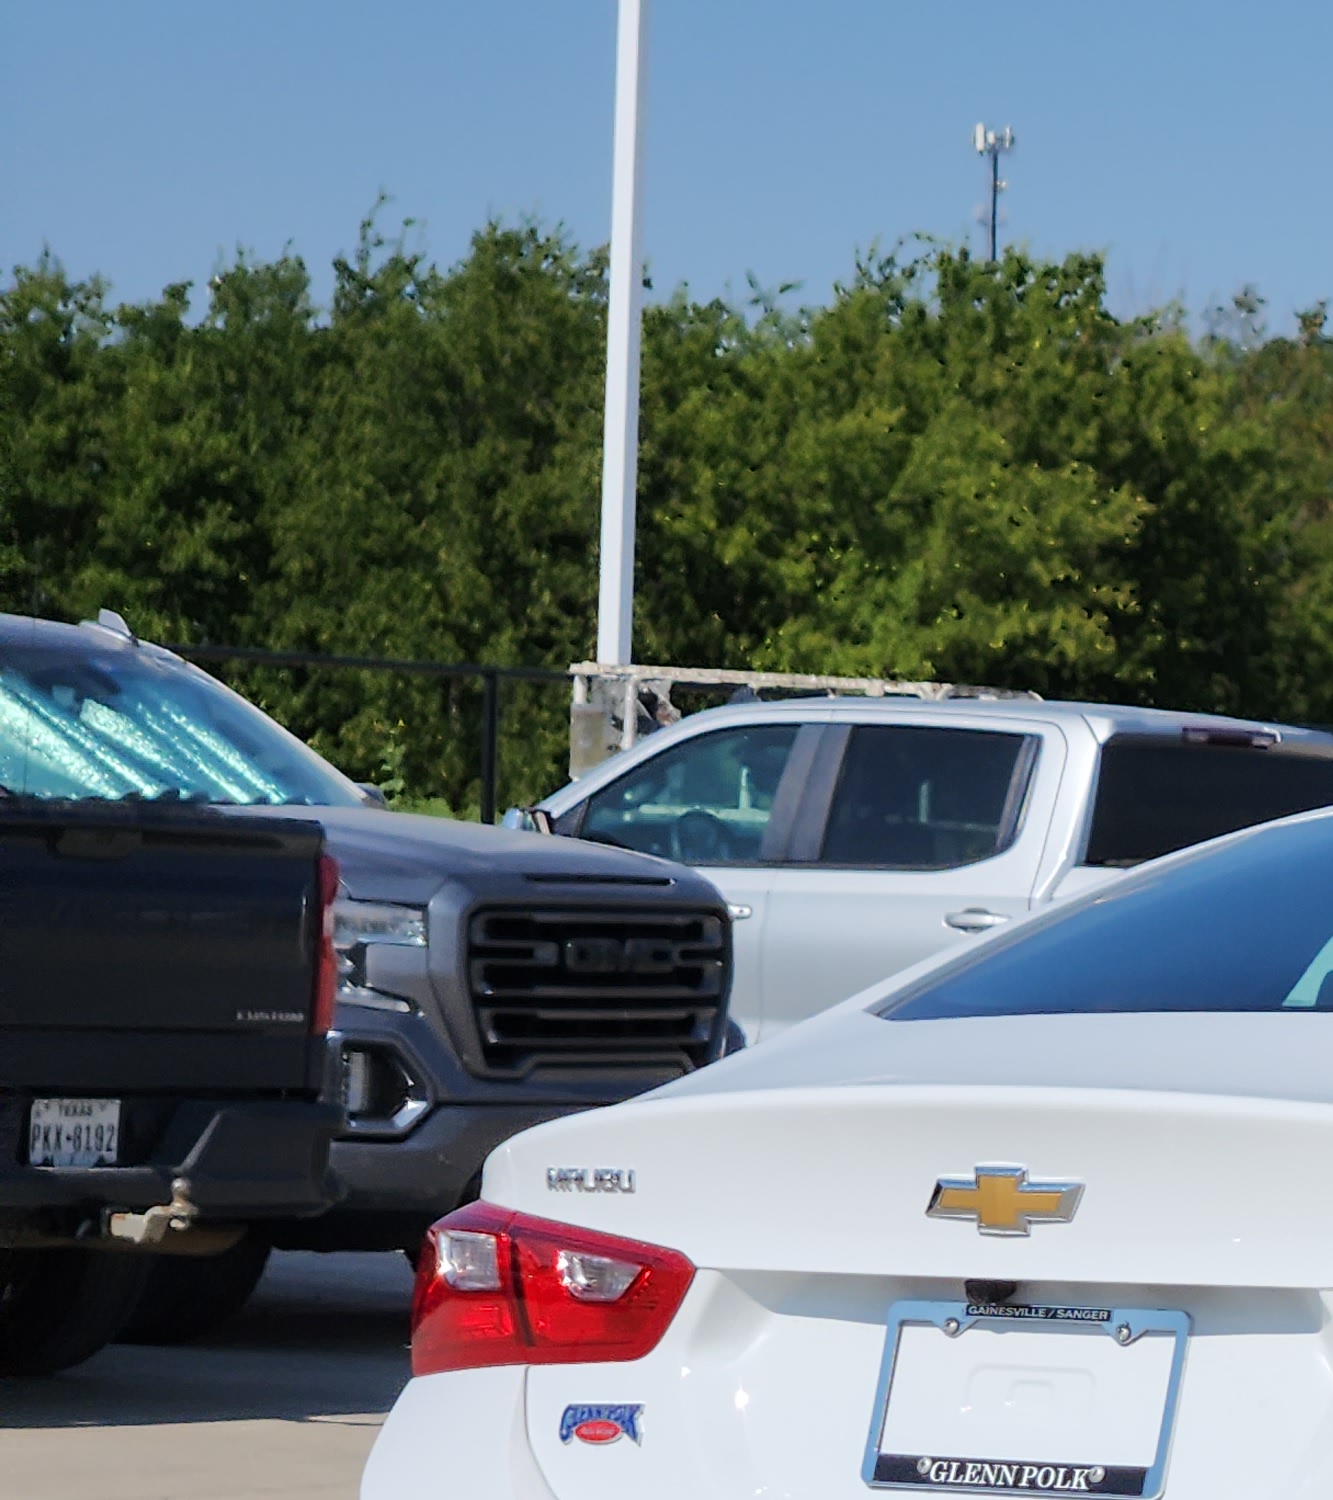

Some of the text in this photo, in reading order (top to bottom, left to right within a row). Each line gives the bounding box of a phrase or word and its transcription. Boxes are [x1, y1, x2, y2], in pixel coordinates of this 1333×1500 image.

[546, 1167, 636, 1193] MALIBU
[968, 1305, 1046, 1318] GAINESVILLE
[1056, 1309, 1108, 1320] SANGER
[929, 1461, 1091, 1491] GLENN POLK
